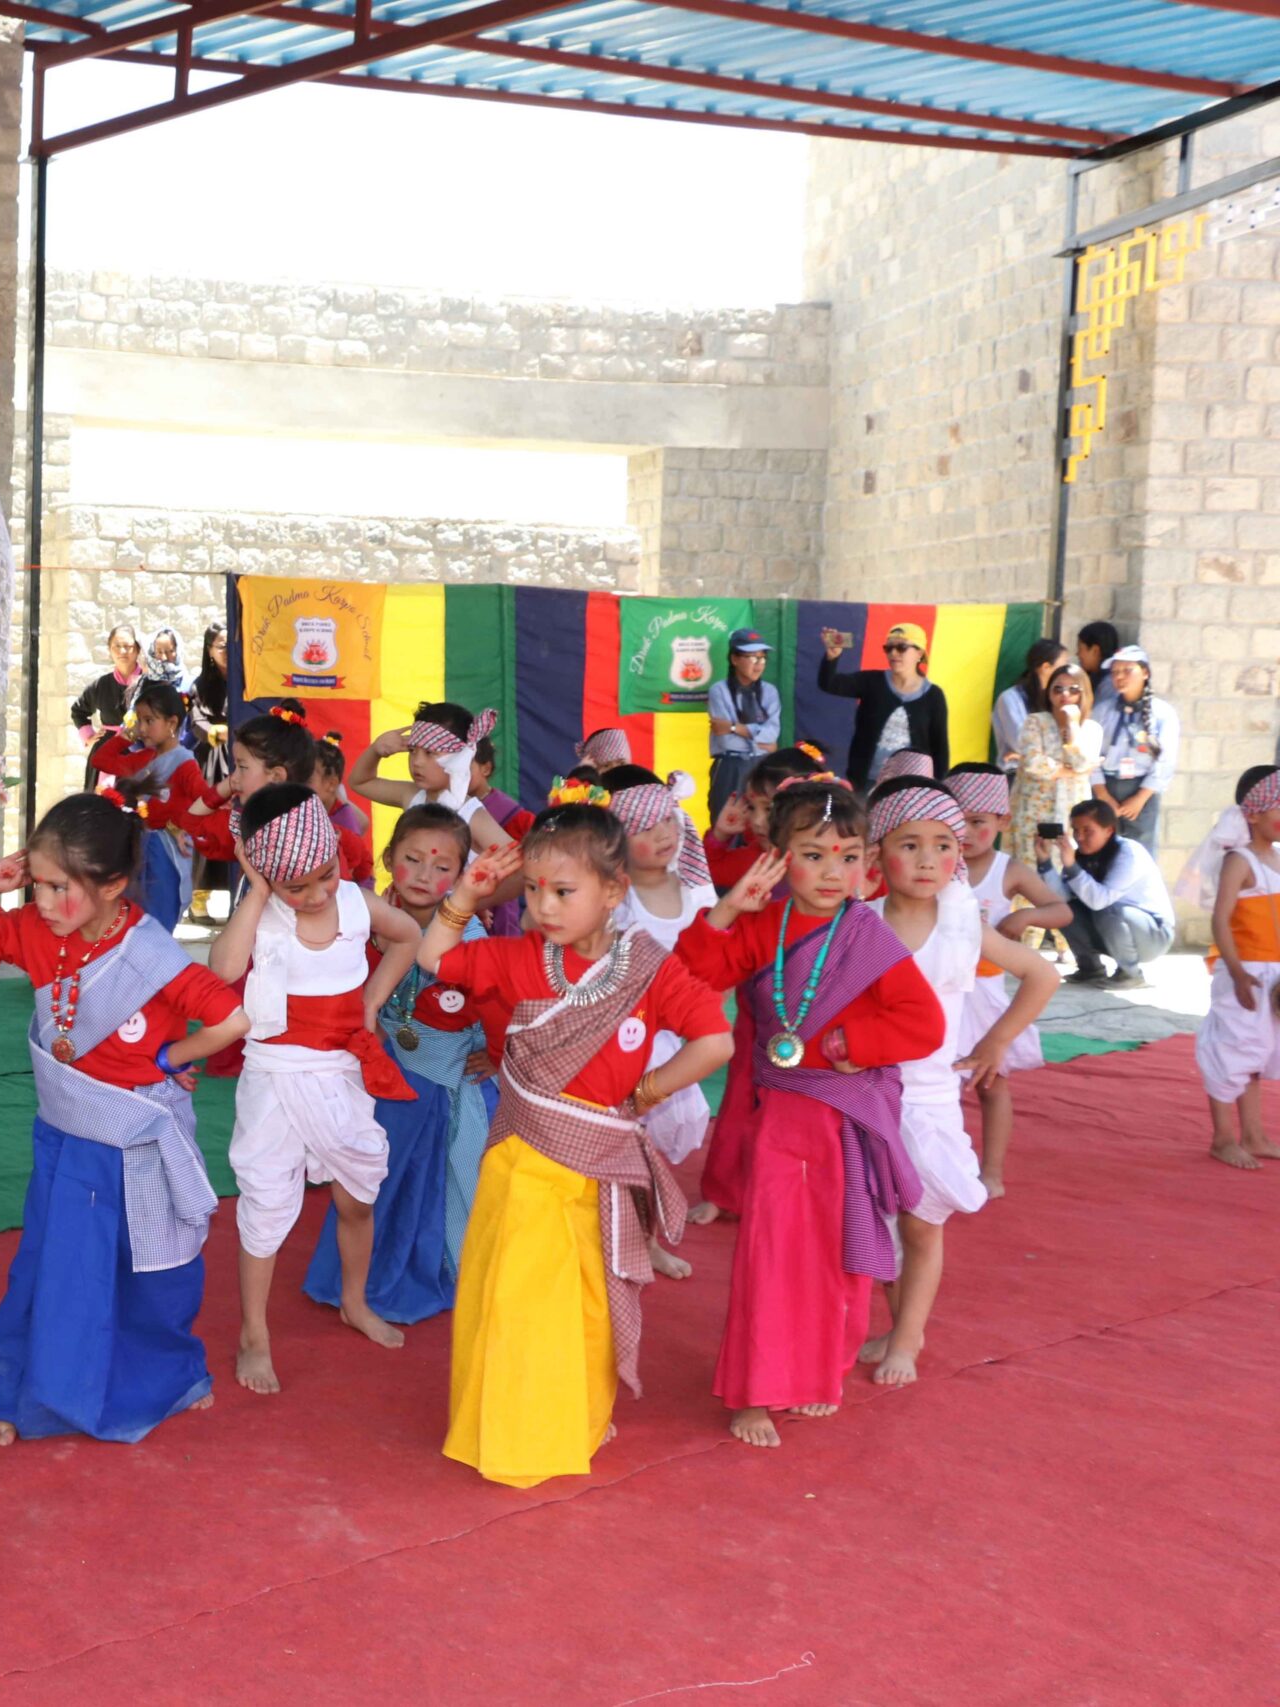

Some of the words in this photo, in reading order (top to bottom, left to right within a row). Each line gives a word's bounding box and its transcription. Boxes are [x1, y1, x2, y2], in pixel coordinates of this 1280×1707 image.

[251, 616, 271, 656] Druk
[268, 589, 309, 618] Padma
[314, 585, 356, 613] Karpo
